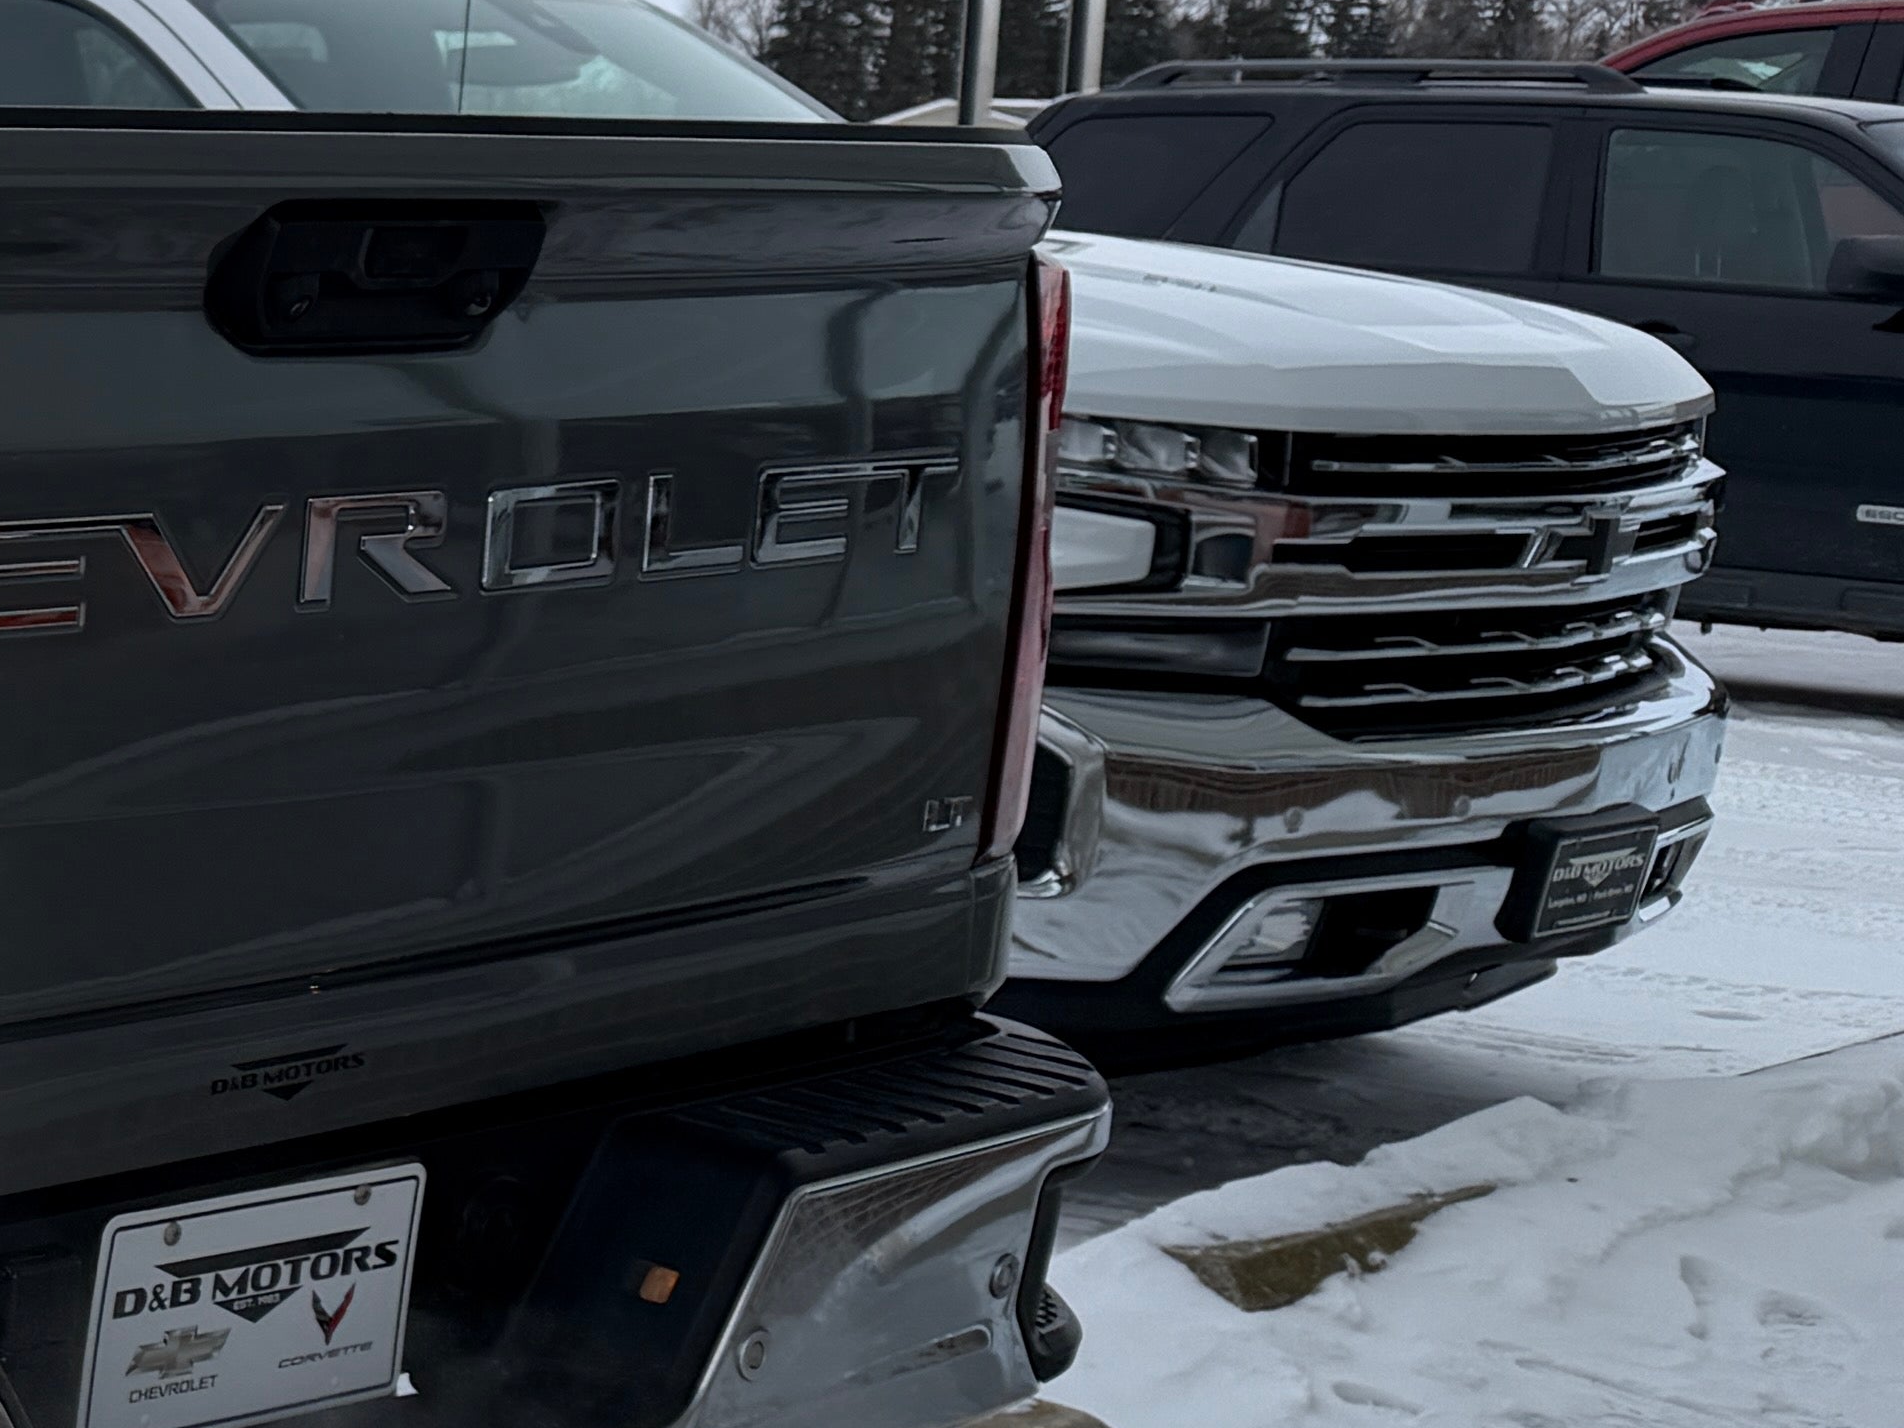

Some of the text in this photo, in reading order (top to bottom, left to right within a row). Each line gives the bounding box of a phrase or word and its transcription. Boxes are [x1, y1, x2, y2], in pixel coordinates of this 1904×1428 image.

[923, 796, 973, 832] LT
[210, 1051, 367, 1096] D&B MOTORS
[112, 1240, 400, 1321] D&B MOTORS
[278, 1341, 374, 1369] CORVETTE
[128, 1374, 219, 1404] CHEVROLET
